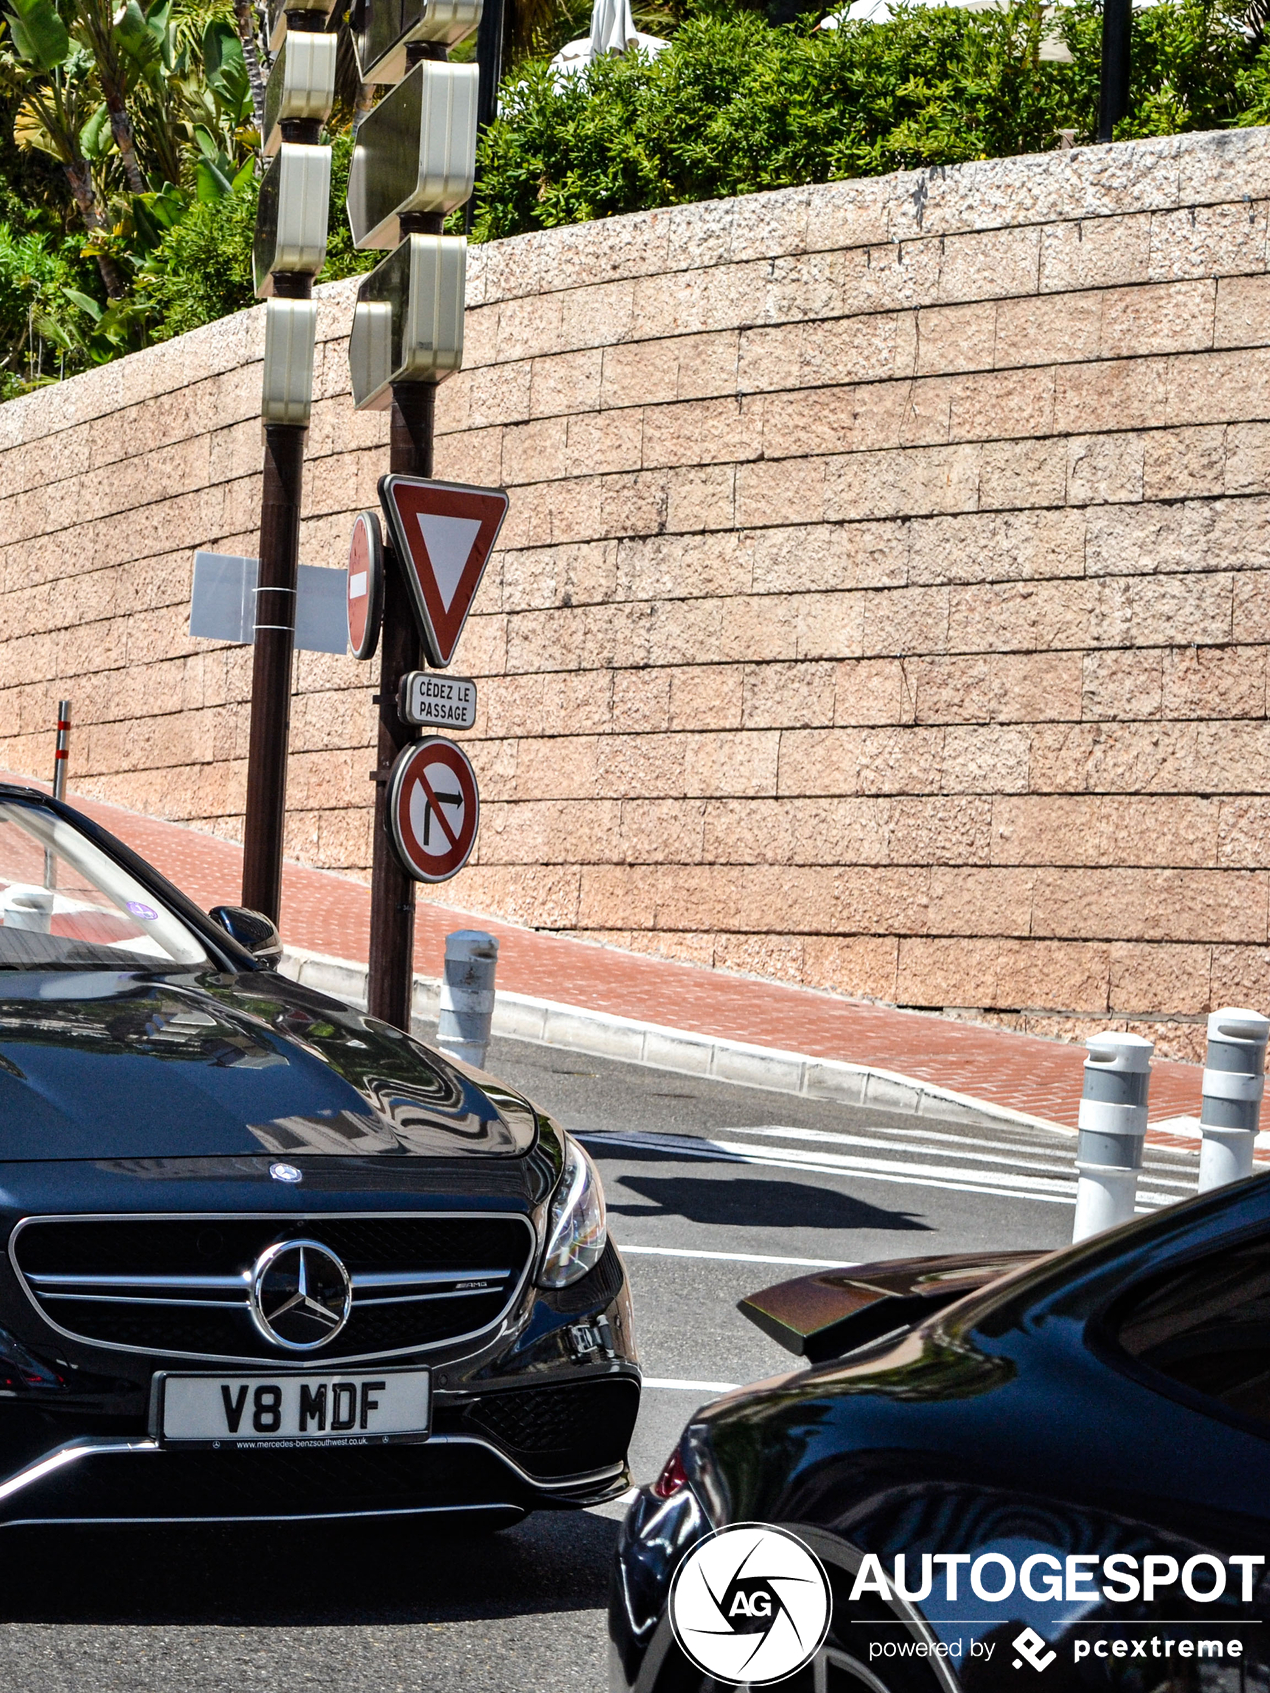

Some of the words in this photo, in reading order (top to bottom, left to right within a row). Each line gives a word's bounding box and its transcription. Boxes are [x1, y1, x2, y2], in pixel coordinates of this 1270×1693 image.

[419, 679, 453, 700] CÉDEZ
[457, 686, 470, 702] LE
[419, 701, 468, 722] PASSAGE
[221, 1384, 282, 1433] V8
[299, 1381, 386, 1432] MDF
[236, 1437, 368, 1449] www.mercedes-benzsouthwest.co.uk
